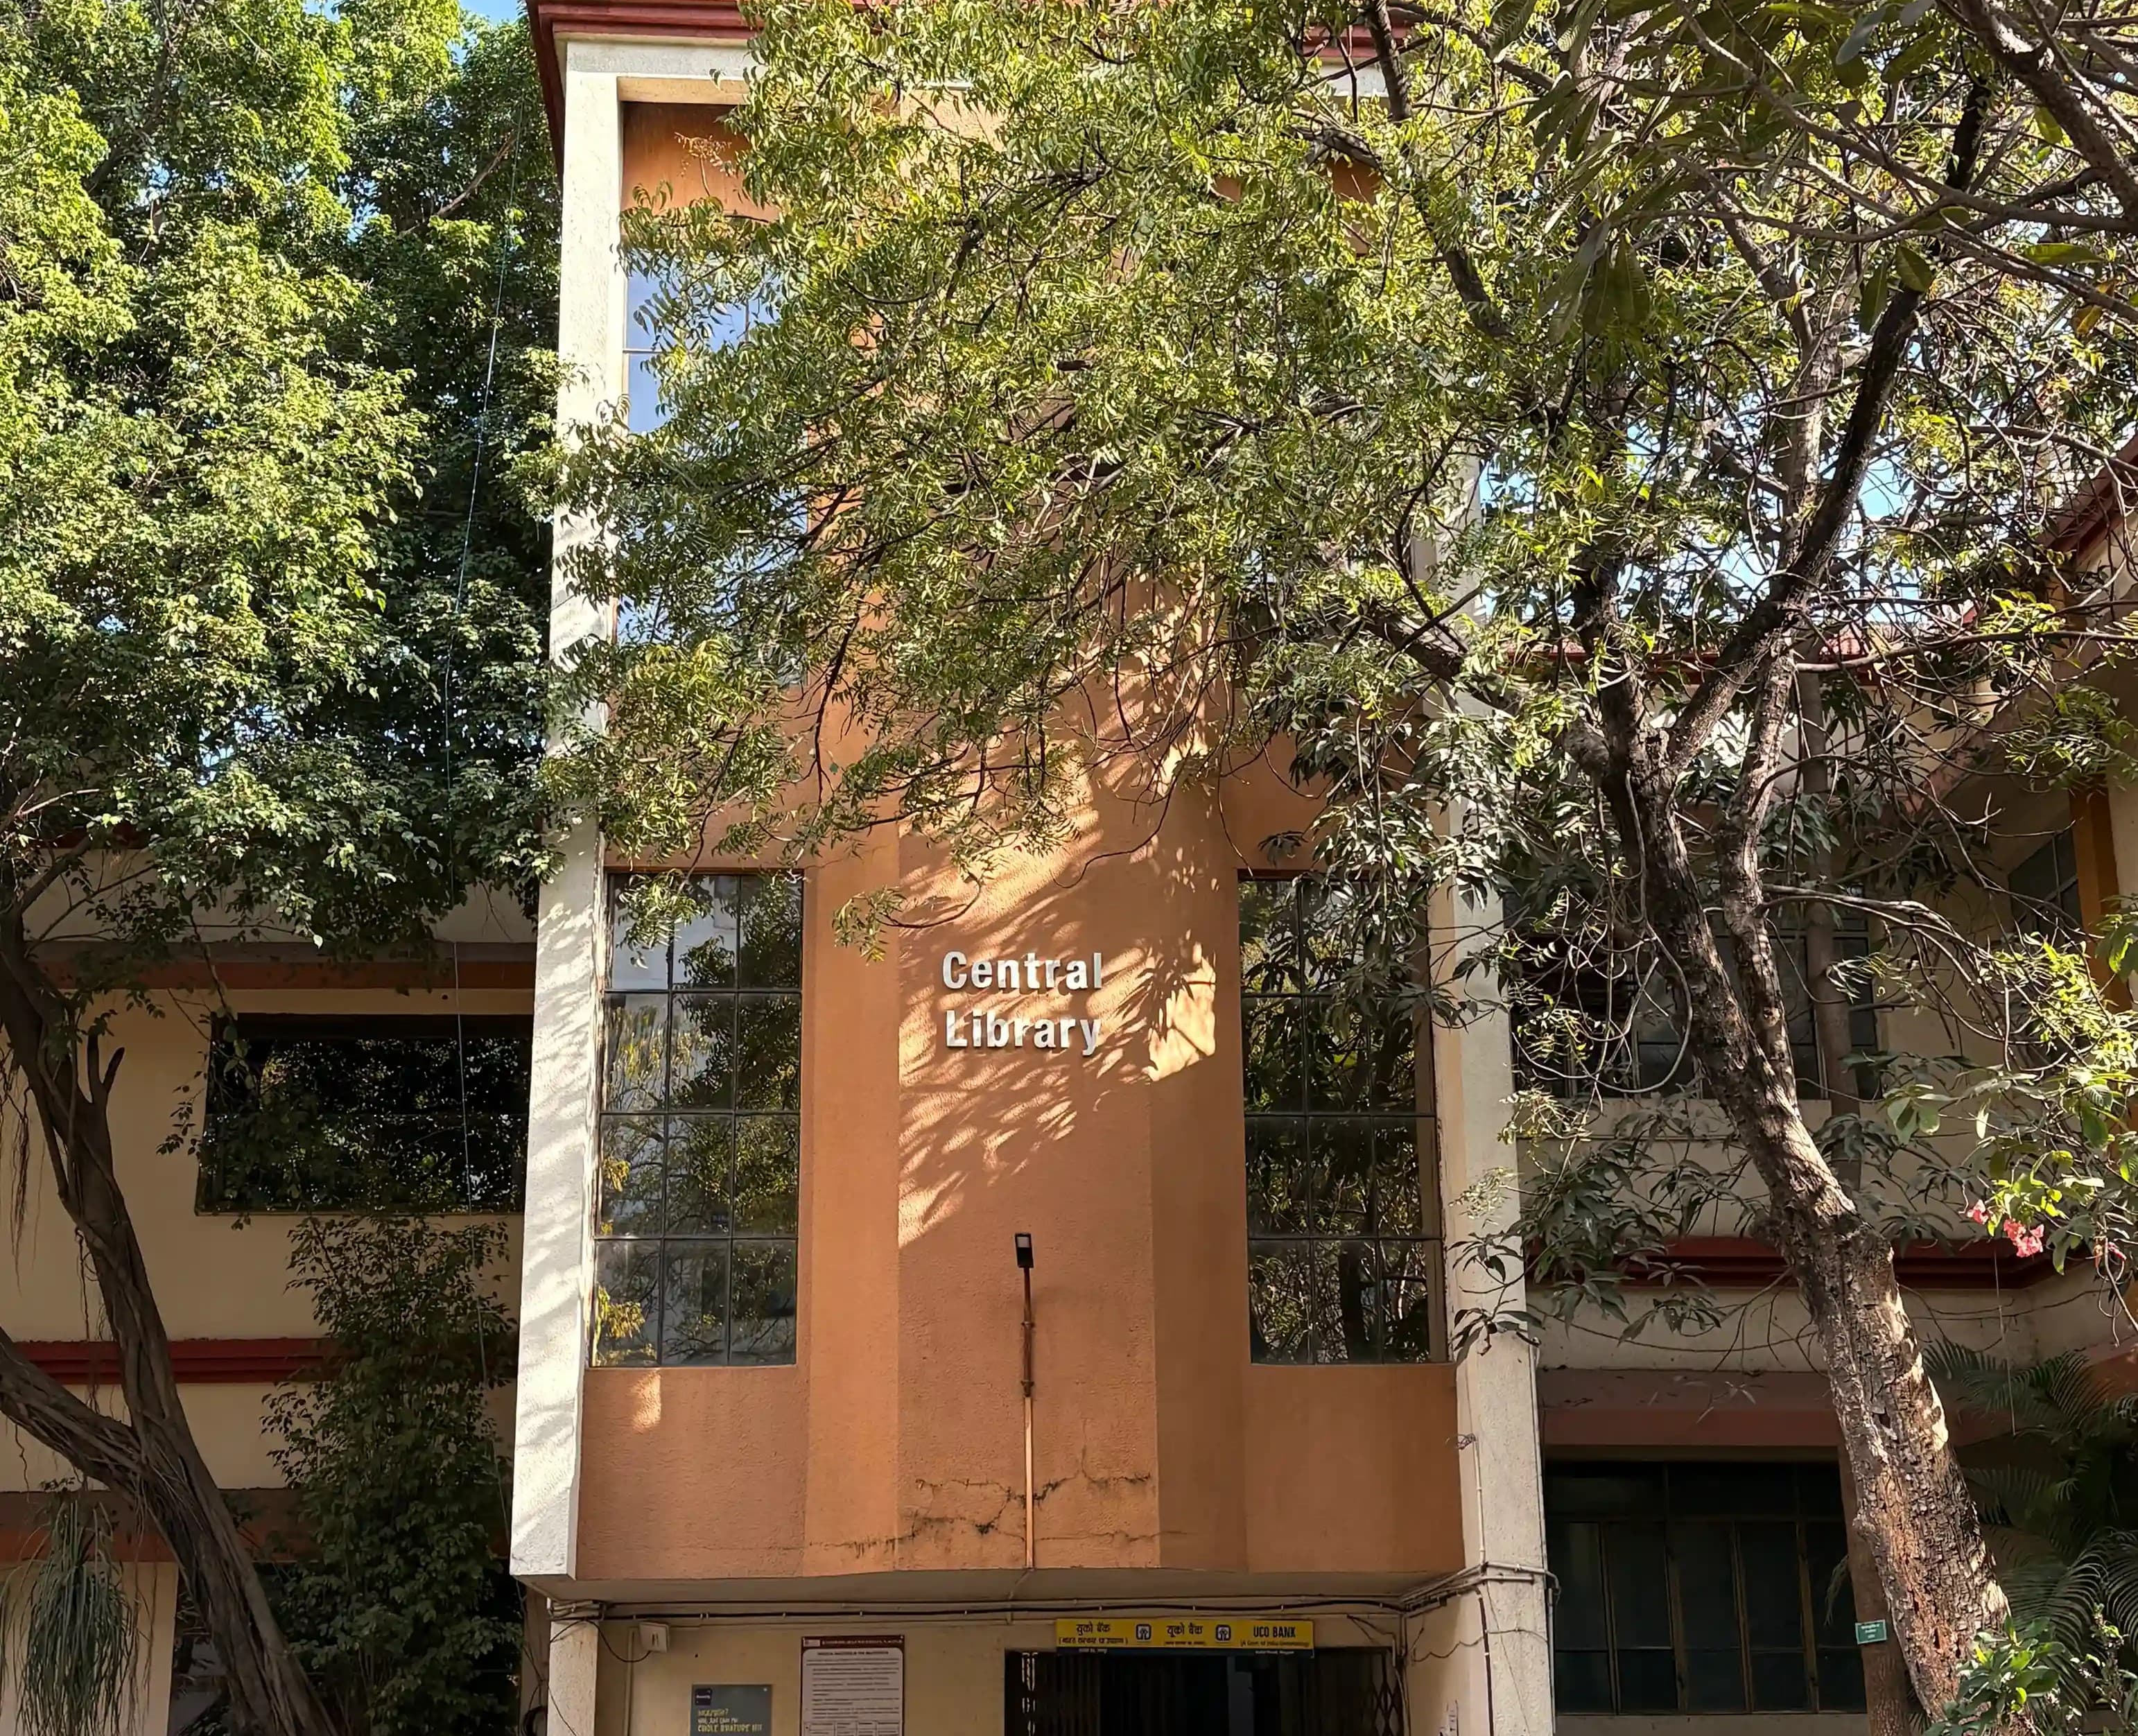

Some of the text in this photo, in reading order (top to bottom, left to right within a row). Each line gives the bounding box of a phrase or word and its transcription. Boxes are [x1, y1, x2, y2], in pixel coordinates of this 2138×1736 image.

[943, 951, 1102, 990] Central
[946, 1010, 1102, 1057] Library
[1253, 1626, 1296, 1638] UCO BANK
